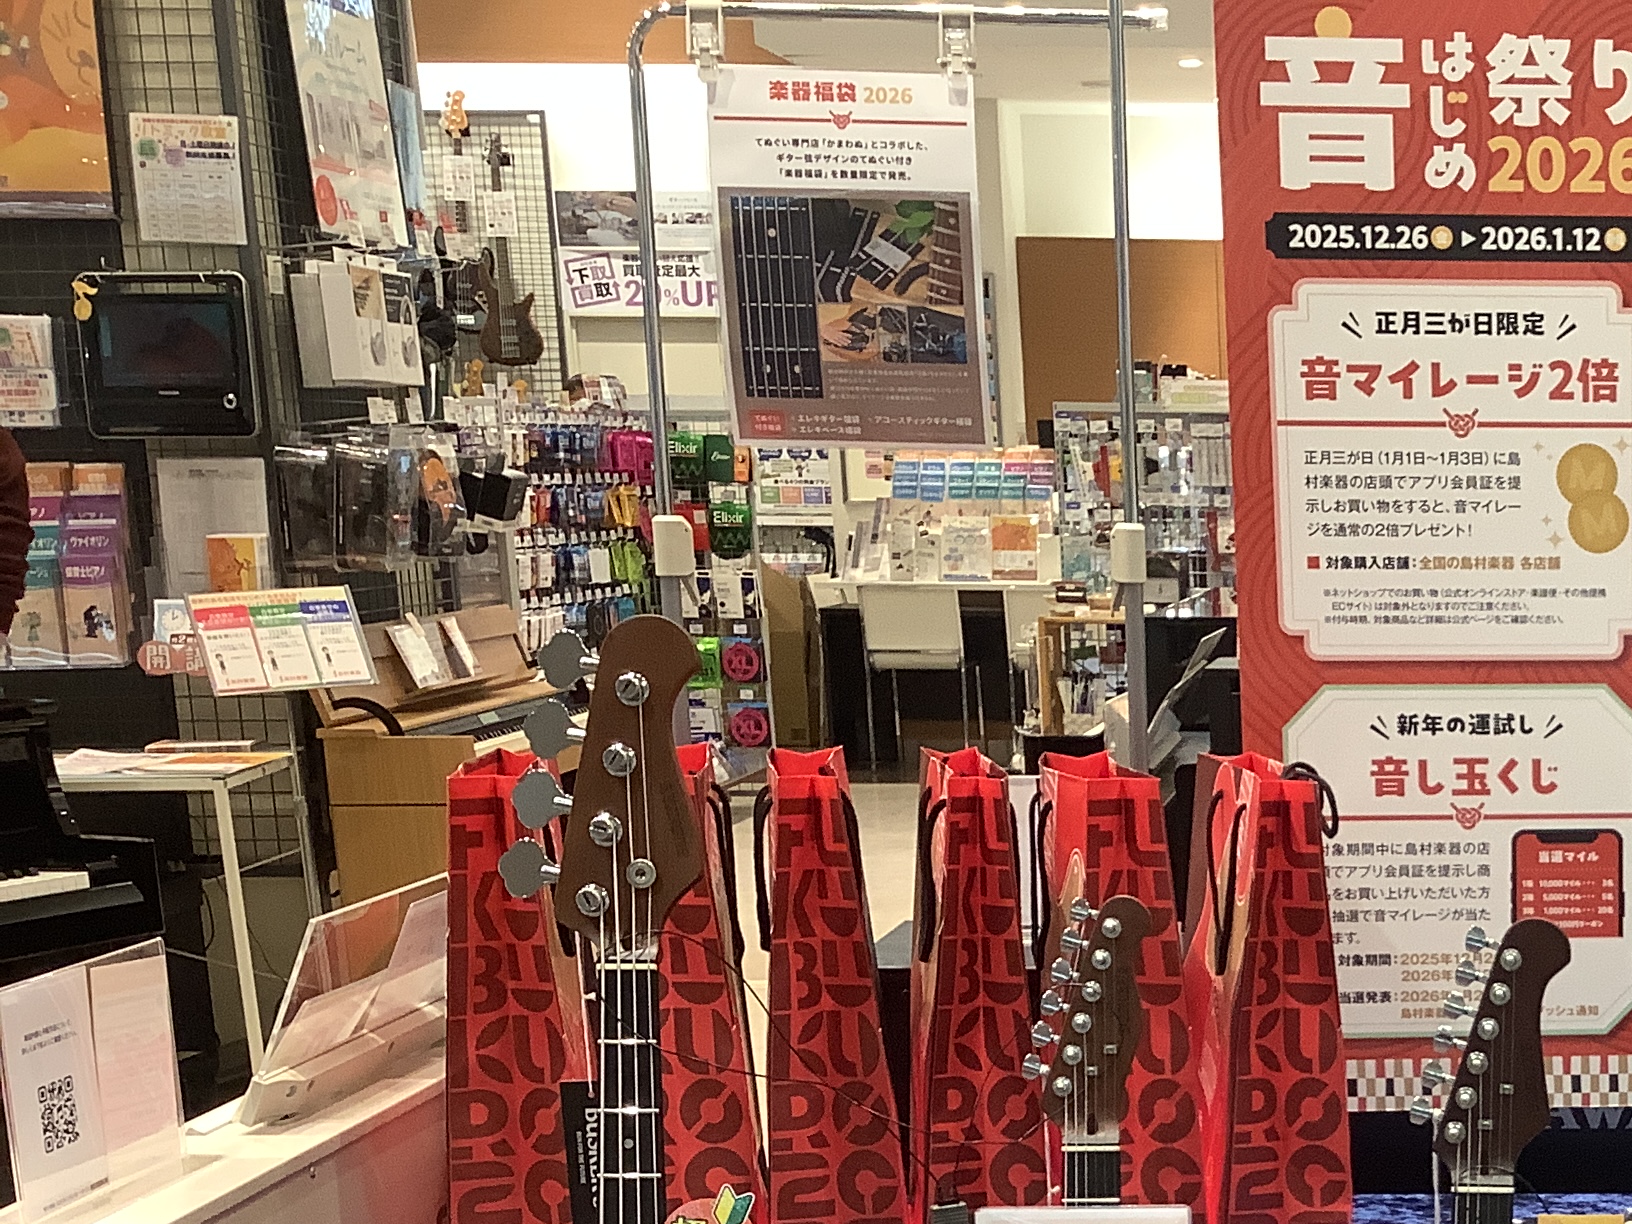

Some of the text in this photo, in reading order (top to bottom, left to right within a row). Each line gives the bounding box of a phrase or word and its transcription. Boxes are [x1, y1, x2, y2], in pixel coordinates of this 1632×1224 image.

[769, 80, 914, 105] 楽器福袋 2026
[1260, 35, 1410, 191] 音
[1421, 32, 1477, 192] はじめ
[572, 265, 611, 285] 下取
[578, 282, 614, 301] 買取
[1375, 312, 1545, 336] 正月三が日限定
[1300, 356, 1619, 403] 音マイレージ2倍
[668, 440, 697, 454] Elixir
[1304, 475, 1522, 491] 村楽器の店頭でアプリ会員証を提
[1305, 499, 1522, 515] 示しお買い物をすると、音マイレー
[713, 511, 744, 524] Elixir
[1307, 523, 1473, 538] ジを通常の2倍プレゼント！
[1521, 557, 1562, 571] 各店舗
[1397, 713, 1534, 736] 新年の運試し
[1370, 757, 1559, 797] 音し玉くじ
[1327, 887, 1490, 900] をお買い上げいただいた方
